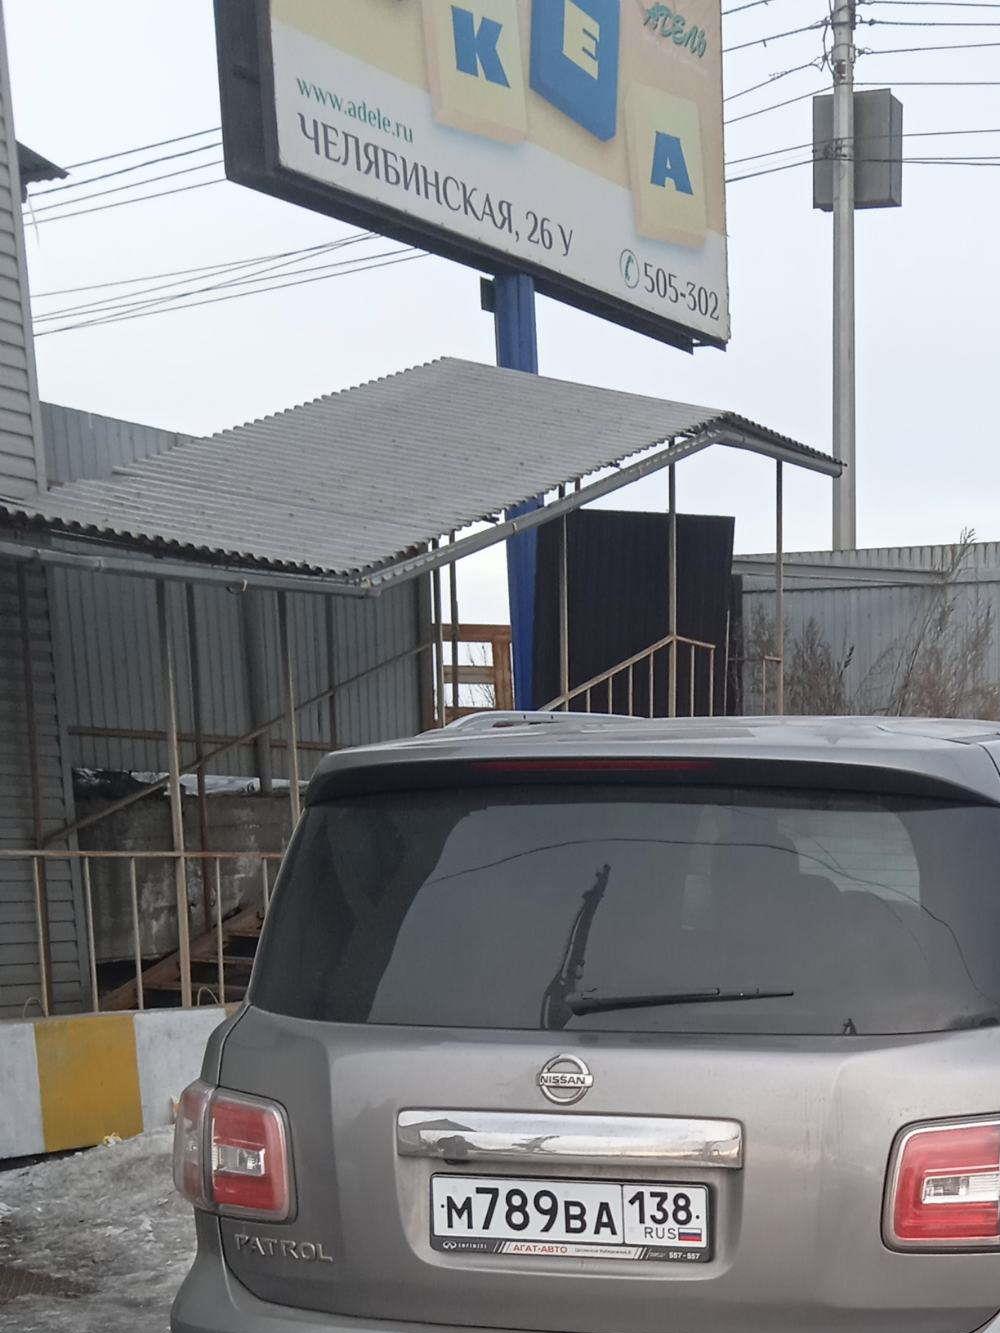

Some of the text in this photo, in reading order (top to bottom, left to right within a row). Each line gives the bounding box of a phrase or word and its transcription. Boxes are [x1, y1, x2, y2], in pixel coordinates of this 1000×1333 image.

[296, 74, 414, 144] www.adele.ru
[297, 112, 520, 242] ЧЕЛЯБИНСКАЯ,
[527, 211, 553, 250] 26
[643, 262, 720, 321] 505-302
[540, 1074, 586, 1085] NISSAN
[628, 1191, 693, 1226] 138
[234, 1233, 334, 1262] PATROL
[644, 1227, 677, 1241] RUS
